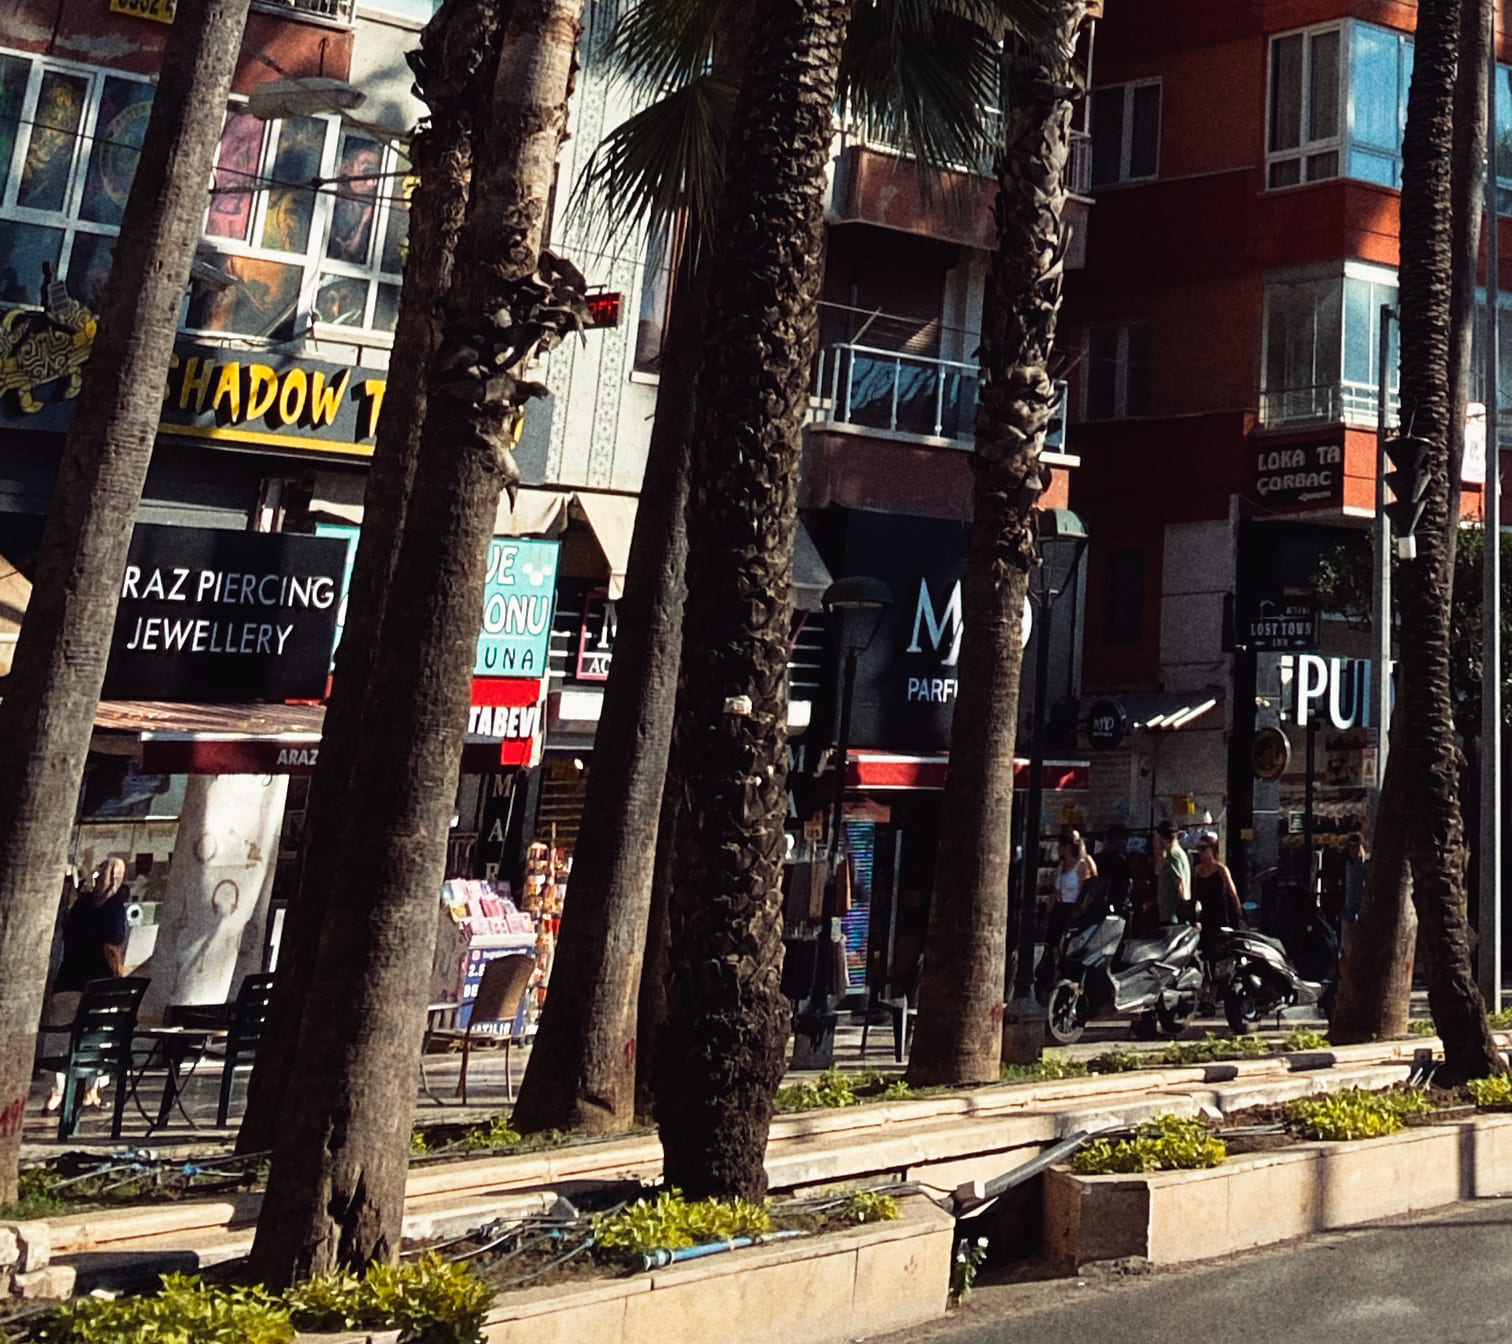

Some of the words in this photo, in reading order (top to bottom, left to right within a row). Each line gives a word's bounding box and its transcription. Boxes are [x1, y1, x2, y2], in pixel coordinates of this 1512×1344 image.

[196, 570, 335, 609] PIERCING
[126, 616, 294, 656] JEWELLERY
[1250, 622, 1279, 637] LOST
[1281, 621, 1313, 637] TOWN
[276, 749, 320, 767] ARAZ
